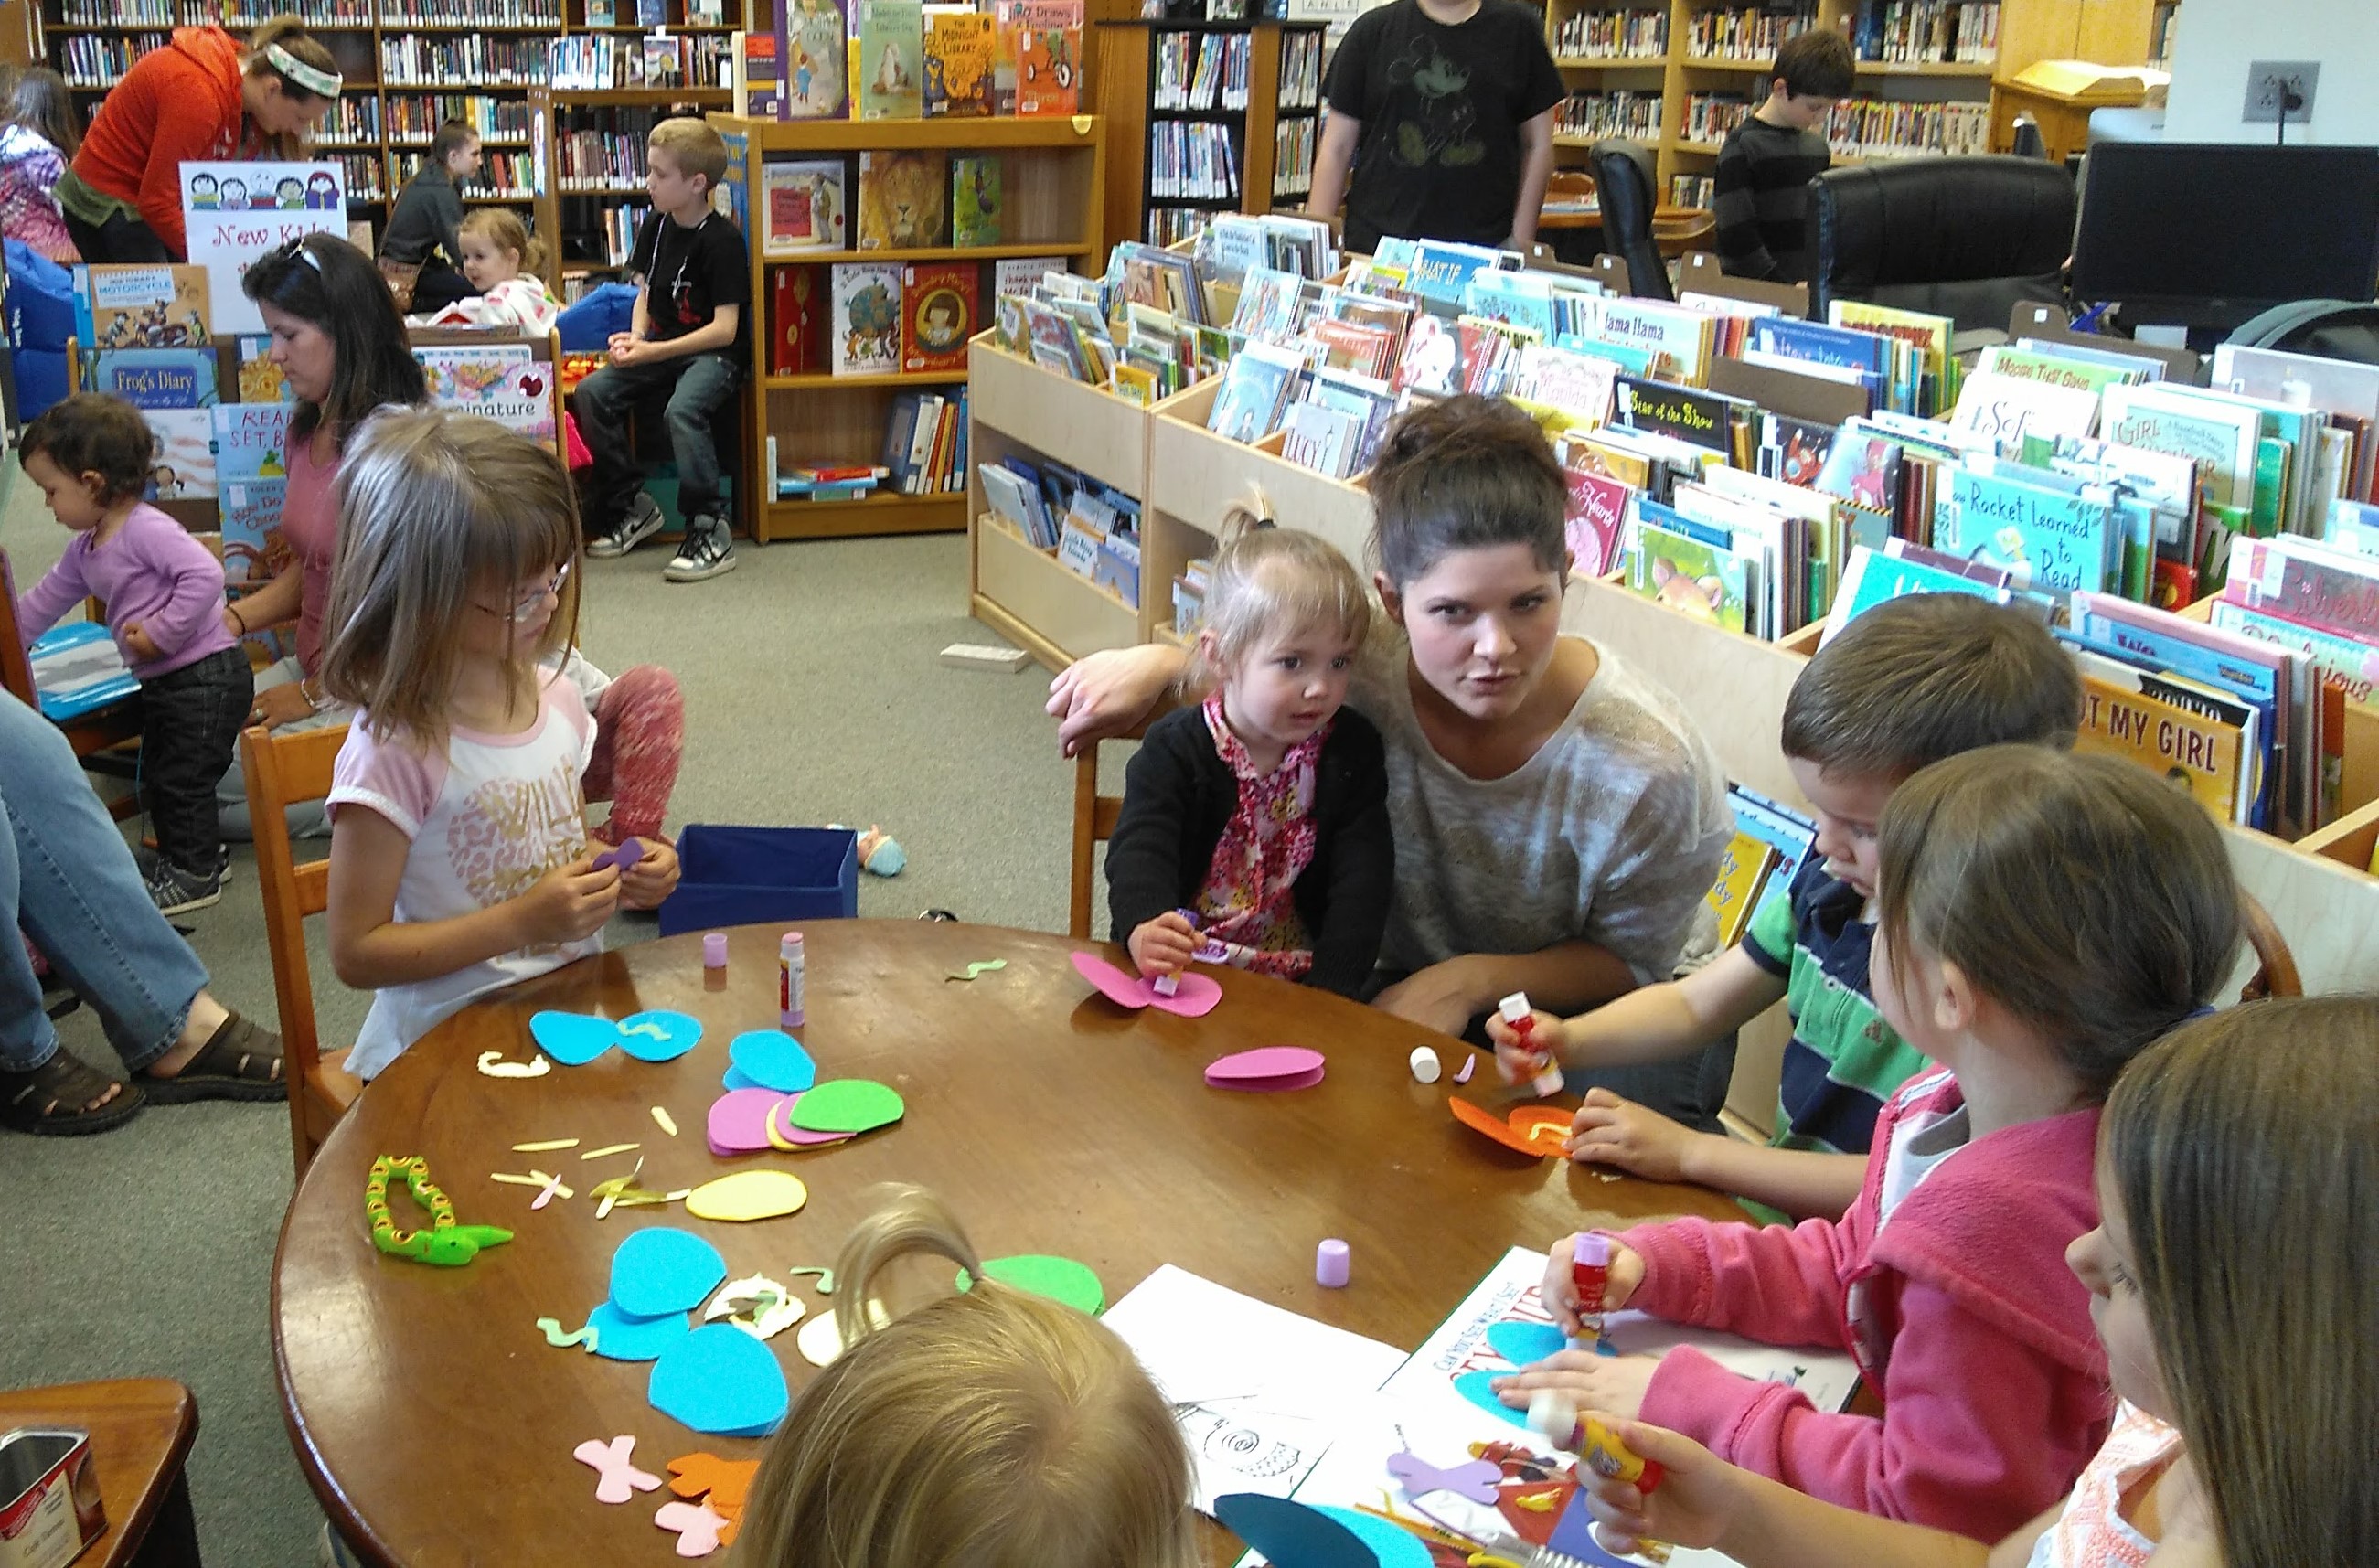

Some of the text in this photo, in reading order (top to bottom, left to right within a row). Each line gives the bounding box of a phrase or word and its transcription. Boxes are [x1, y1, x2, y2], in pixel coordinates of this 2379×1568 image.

[212, 223, 268, 247] New
[99, 281, 171, 294] MOTORCYCLE
[1632, 317, 1665, 341] llama
[117, 369, 193, 394] Frog's Diary
[1656, 402, 1666, 421] of
[1667, 404, 1681, 423] the
[1682, 401, 1714, 430] Show
[2118, 415, 2160, 445] GIRL
[1970, 481, 2025, 523] Rocket
[2031, 500, 2090, 539] Learned
[2057, 537, 2073, 563] to
[2040, 547, 2083, 591] Read
[2108, 702, 2149, 747] MY
[2158, 719, 2217, 773] GIRL
